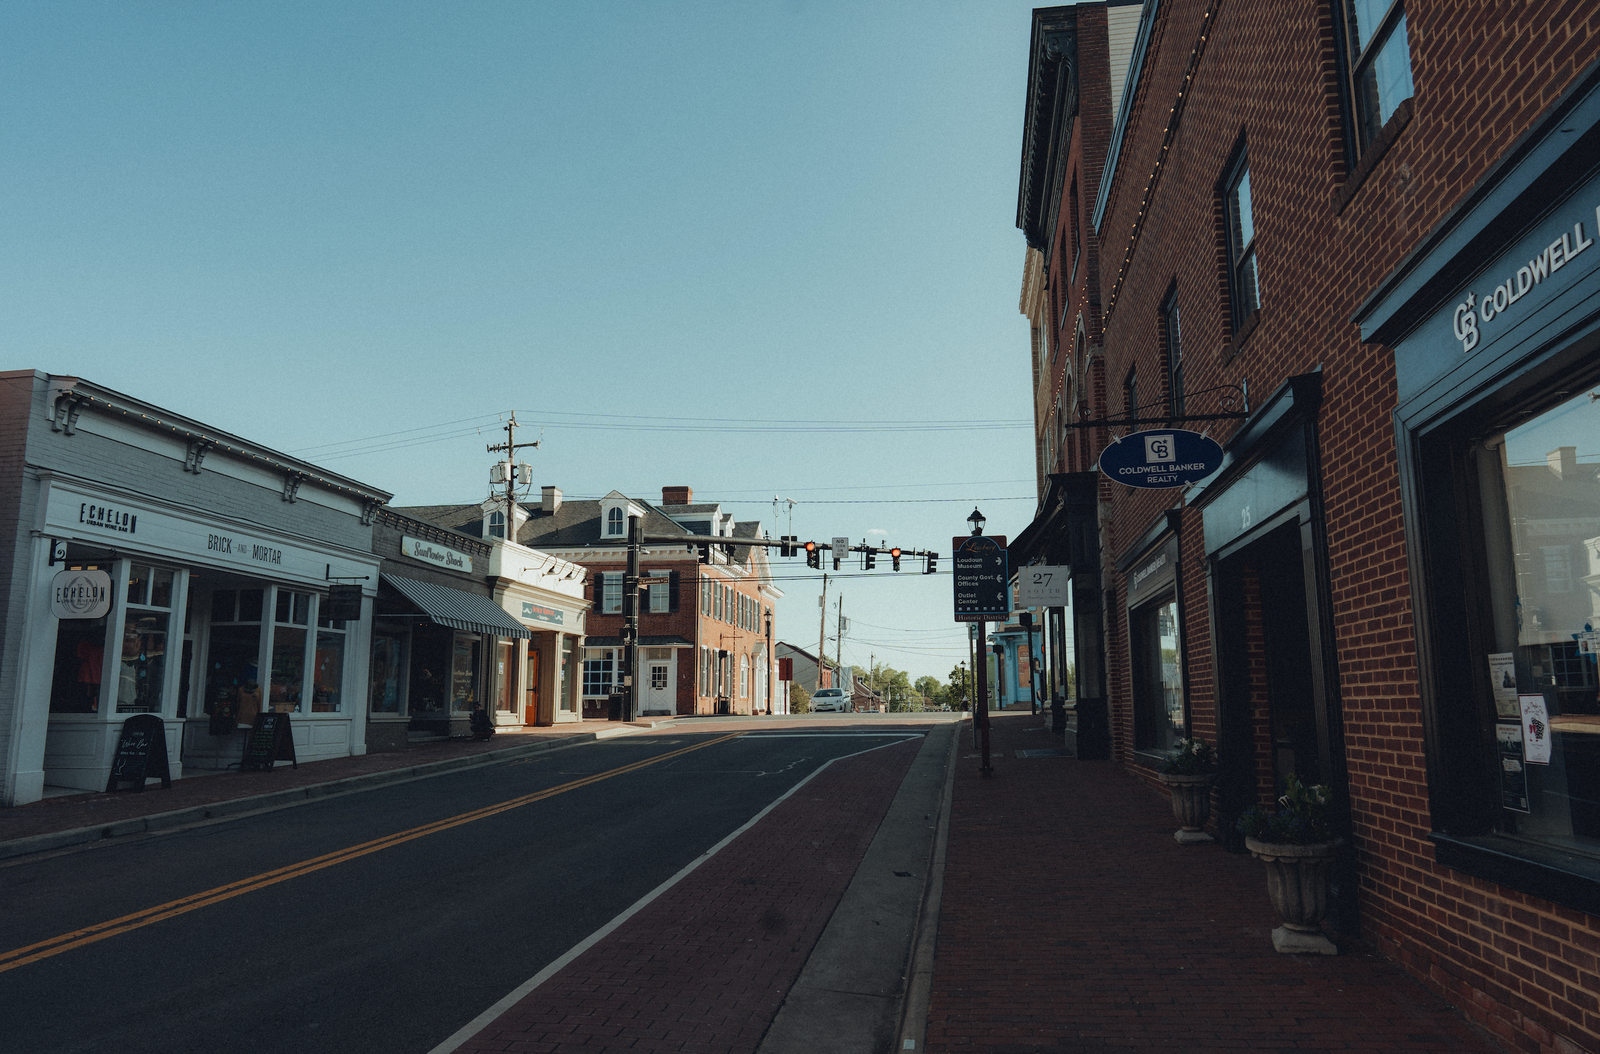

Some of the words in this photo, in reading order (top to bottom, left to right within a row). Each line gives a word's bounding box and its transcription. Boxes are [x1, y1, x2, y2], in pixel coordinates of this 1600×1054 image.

[1480, 222, 1594, 323] COLDWELL
[1118, 464, 1168, 475] COLDWELL
[1168, 462, 1206, 472] BANKER
[1146, 475, 1179, 484] REALTY
[79, 503, 137, 533] ECHELON
[86, 519, 104, 528] URBAN
[104, 522, 118, 531] WINE
[1241, 505, 1251, 529] 25
[207, 533, 233, 554] BRICK
[237, 543, 247, 554] AND
[252, 544, 282, 565] MORTAR
[414, 541, 445, 562] Sunflower
[445, 551, 464, 568] Shack
[965, 540, 997, 556] Leesburg
[1033, 572, 1053, 588] 27
[56, 586, 105, 603] ECHELON
